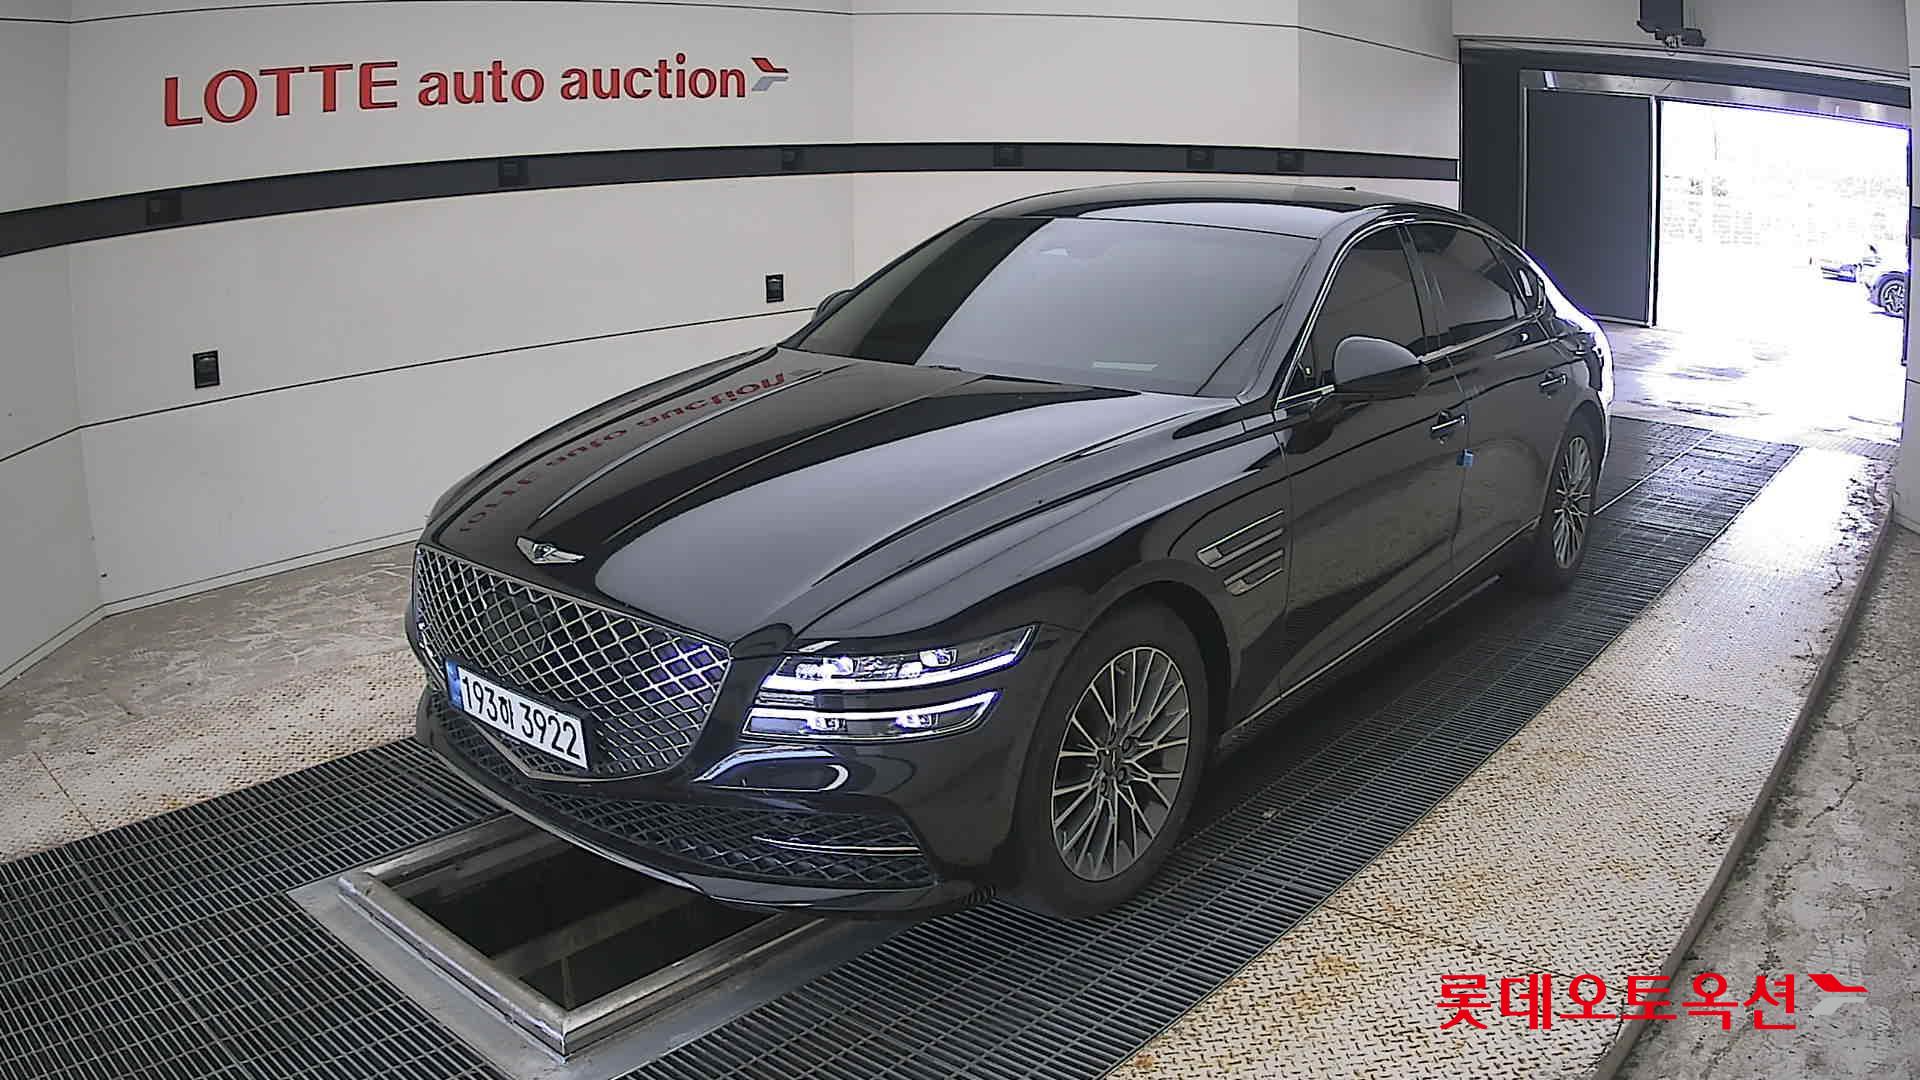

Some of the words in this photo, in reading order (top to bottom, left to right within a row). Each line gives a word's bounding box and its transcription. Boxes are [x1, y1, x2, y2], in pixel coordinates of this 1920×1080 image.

[164, 61, 398, 126] LOTTE
[417, 59, 545, 106] auto
[560, 52, 747, 100] auction
[462, 676, 515, 730] 193하
[519, 702, 581, 760] 3922
